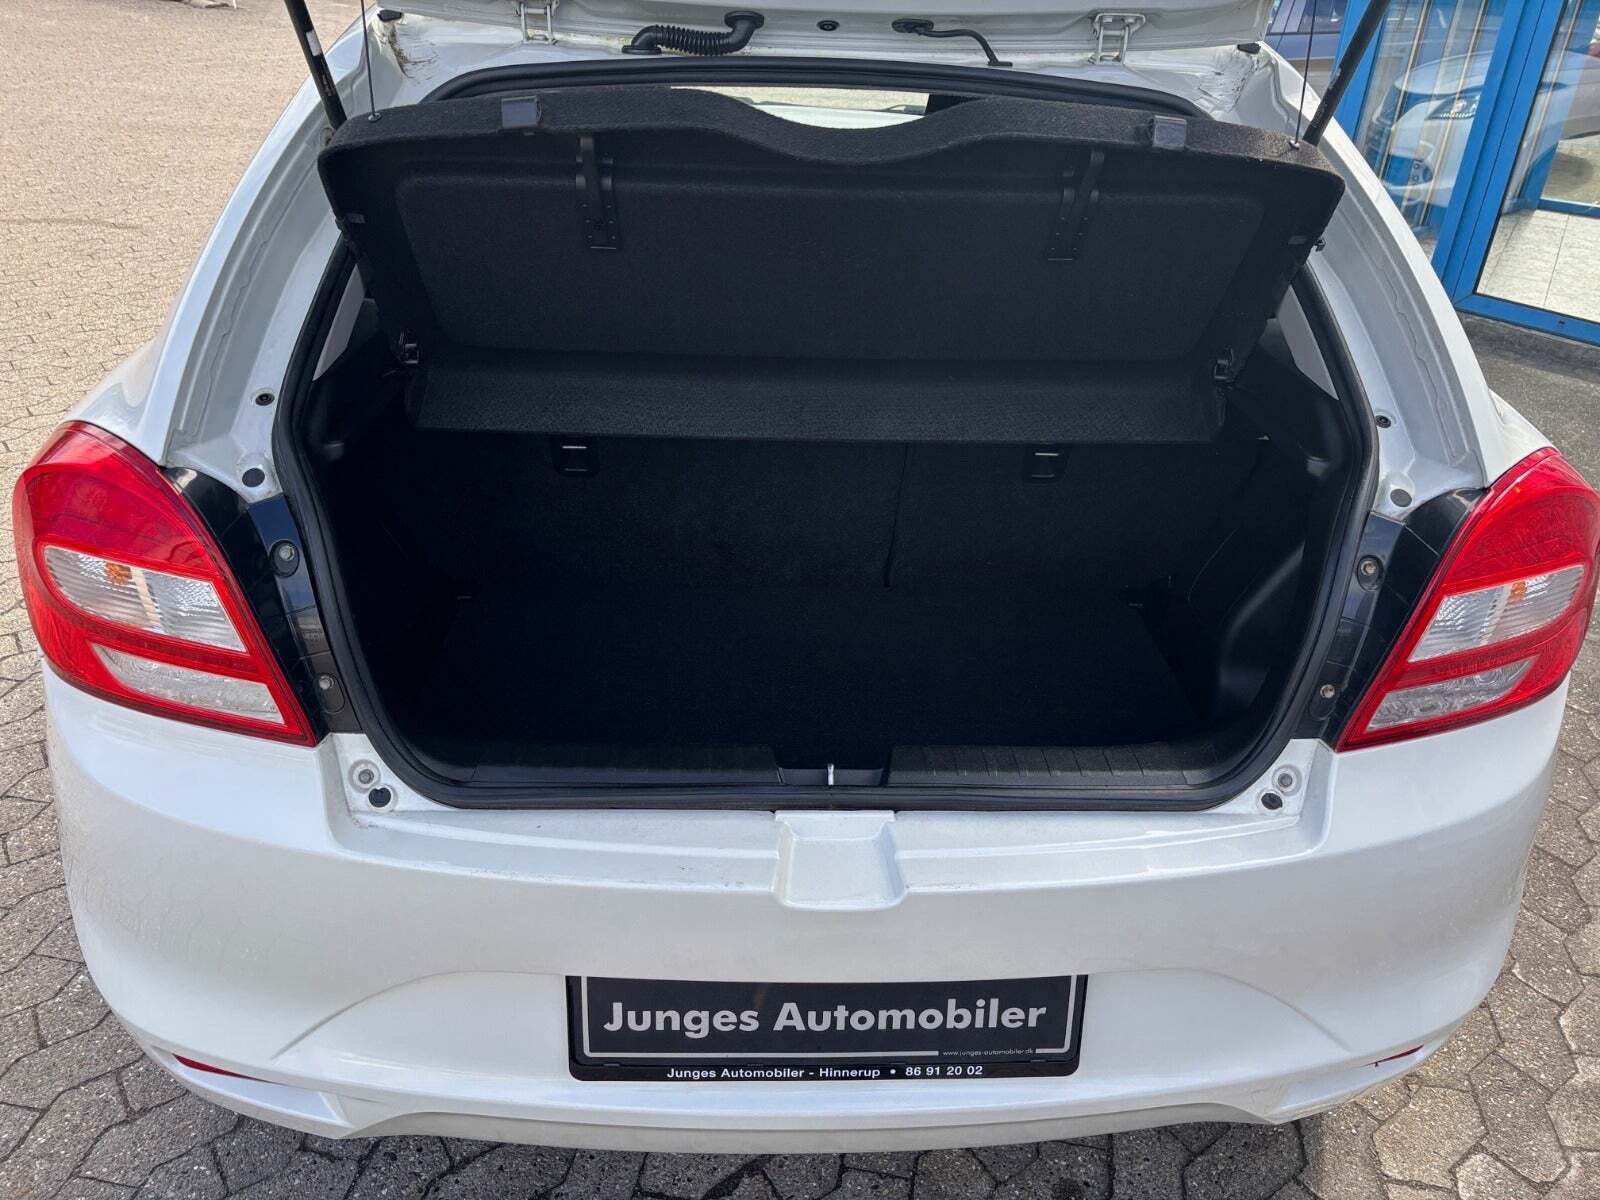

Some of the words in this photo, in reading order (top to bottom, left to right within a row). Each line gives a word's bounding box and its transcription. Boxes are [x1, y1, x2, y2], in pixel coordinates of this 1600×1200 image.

[603, 1001, 760, 1039] Junges
[772, 998, 1047, 1032] Automobiler
[666, 1067, 717, 1080] Junges
[720, 1067, 805, 1079] Automobiler
[819, 1066, 881, 1079] Hinnerup
[905, 1066, 922, 1077] 86
[926, 1066, 941, 1077] 91
[946, 1065, 962, 1076] 20
[966, 1065, 984, 1076] 02
